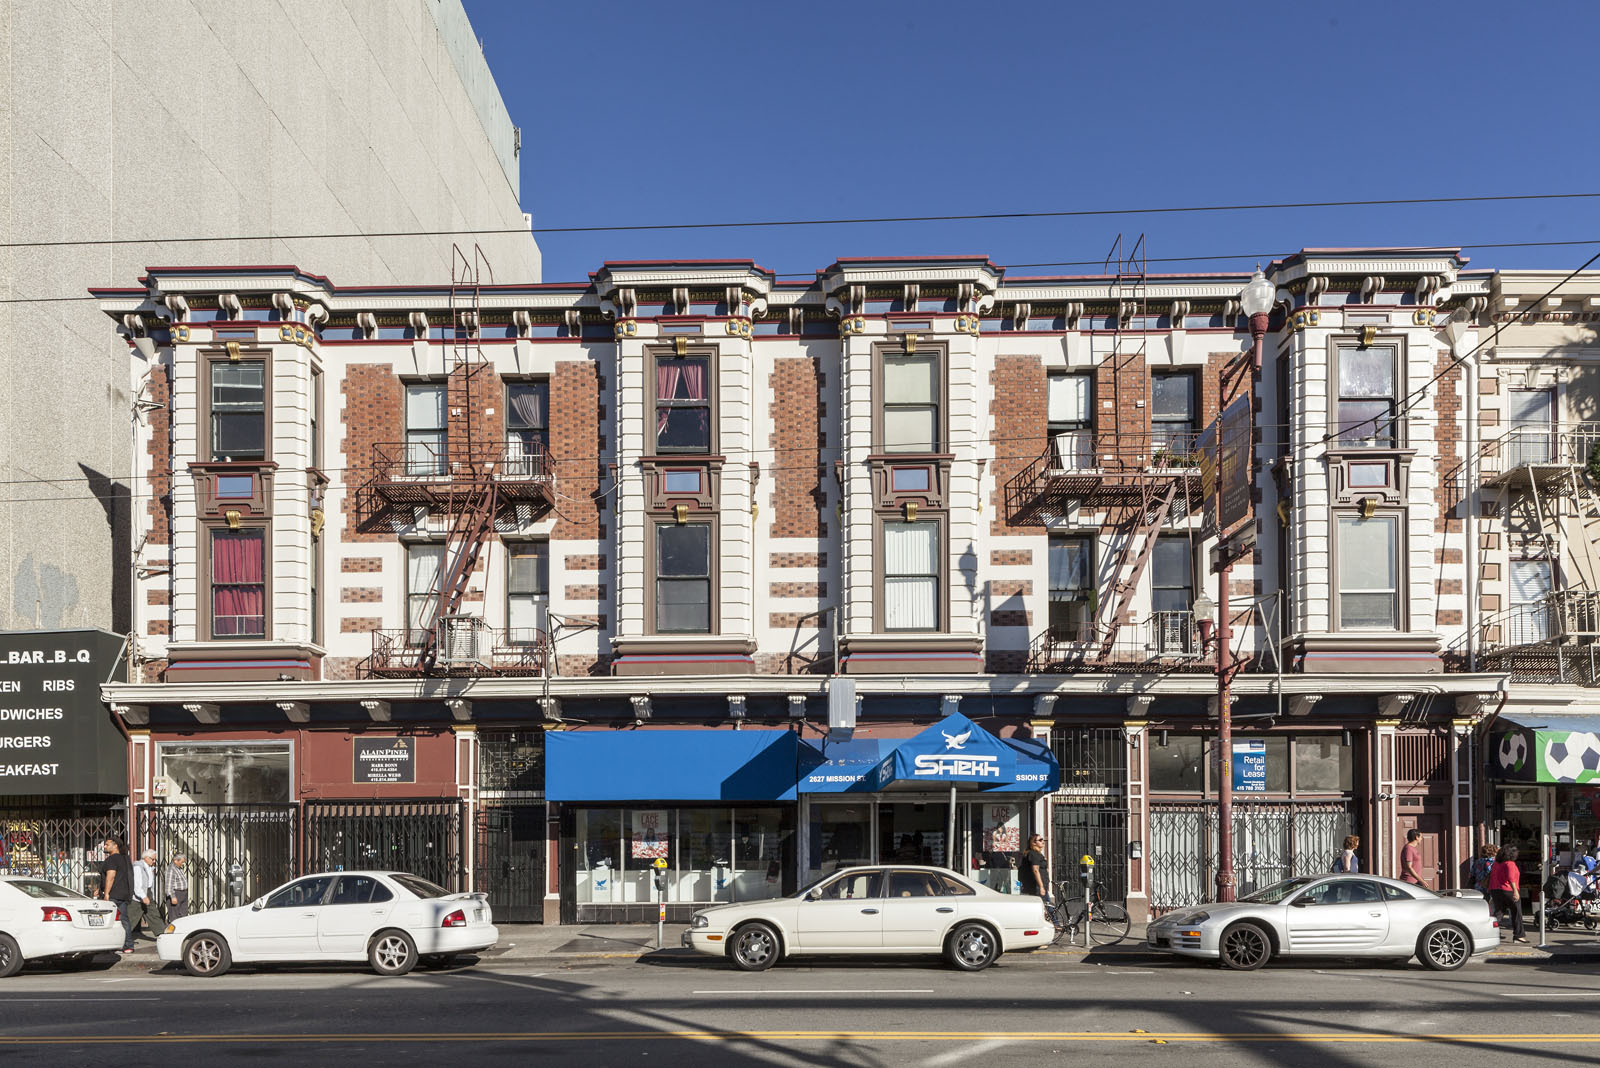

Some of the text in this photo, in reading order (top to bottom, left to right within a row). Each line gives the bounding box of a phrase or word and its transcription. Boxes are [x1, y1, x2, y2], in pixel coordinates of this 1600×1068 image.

[43, 680, 75, 692] RIBS
[1243, 756, 1265, 764] Retail
[1243, 770, 1265, 778] Lease
[992, 807, 1010, 818] LACE
